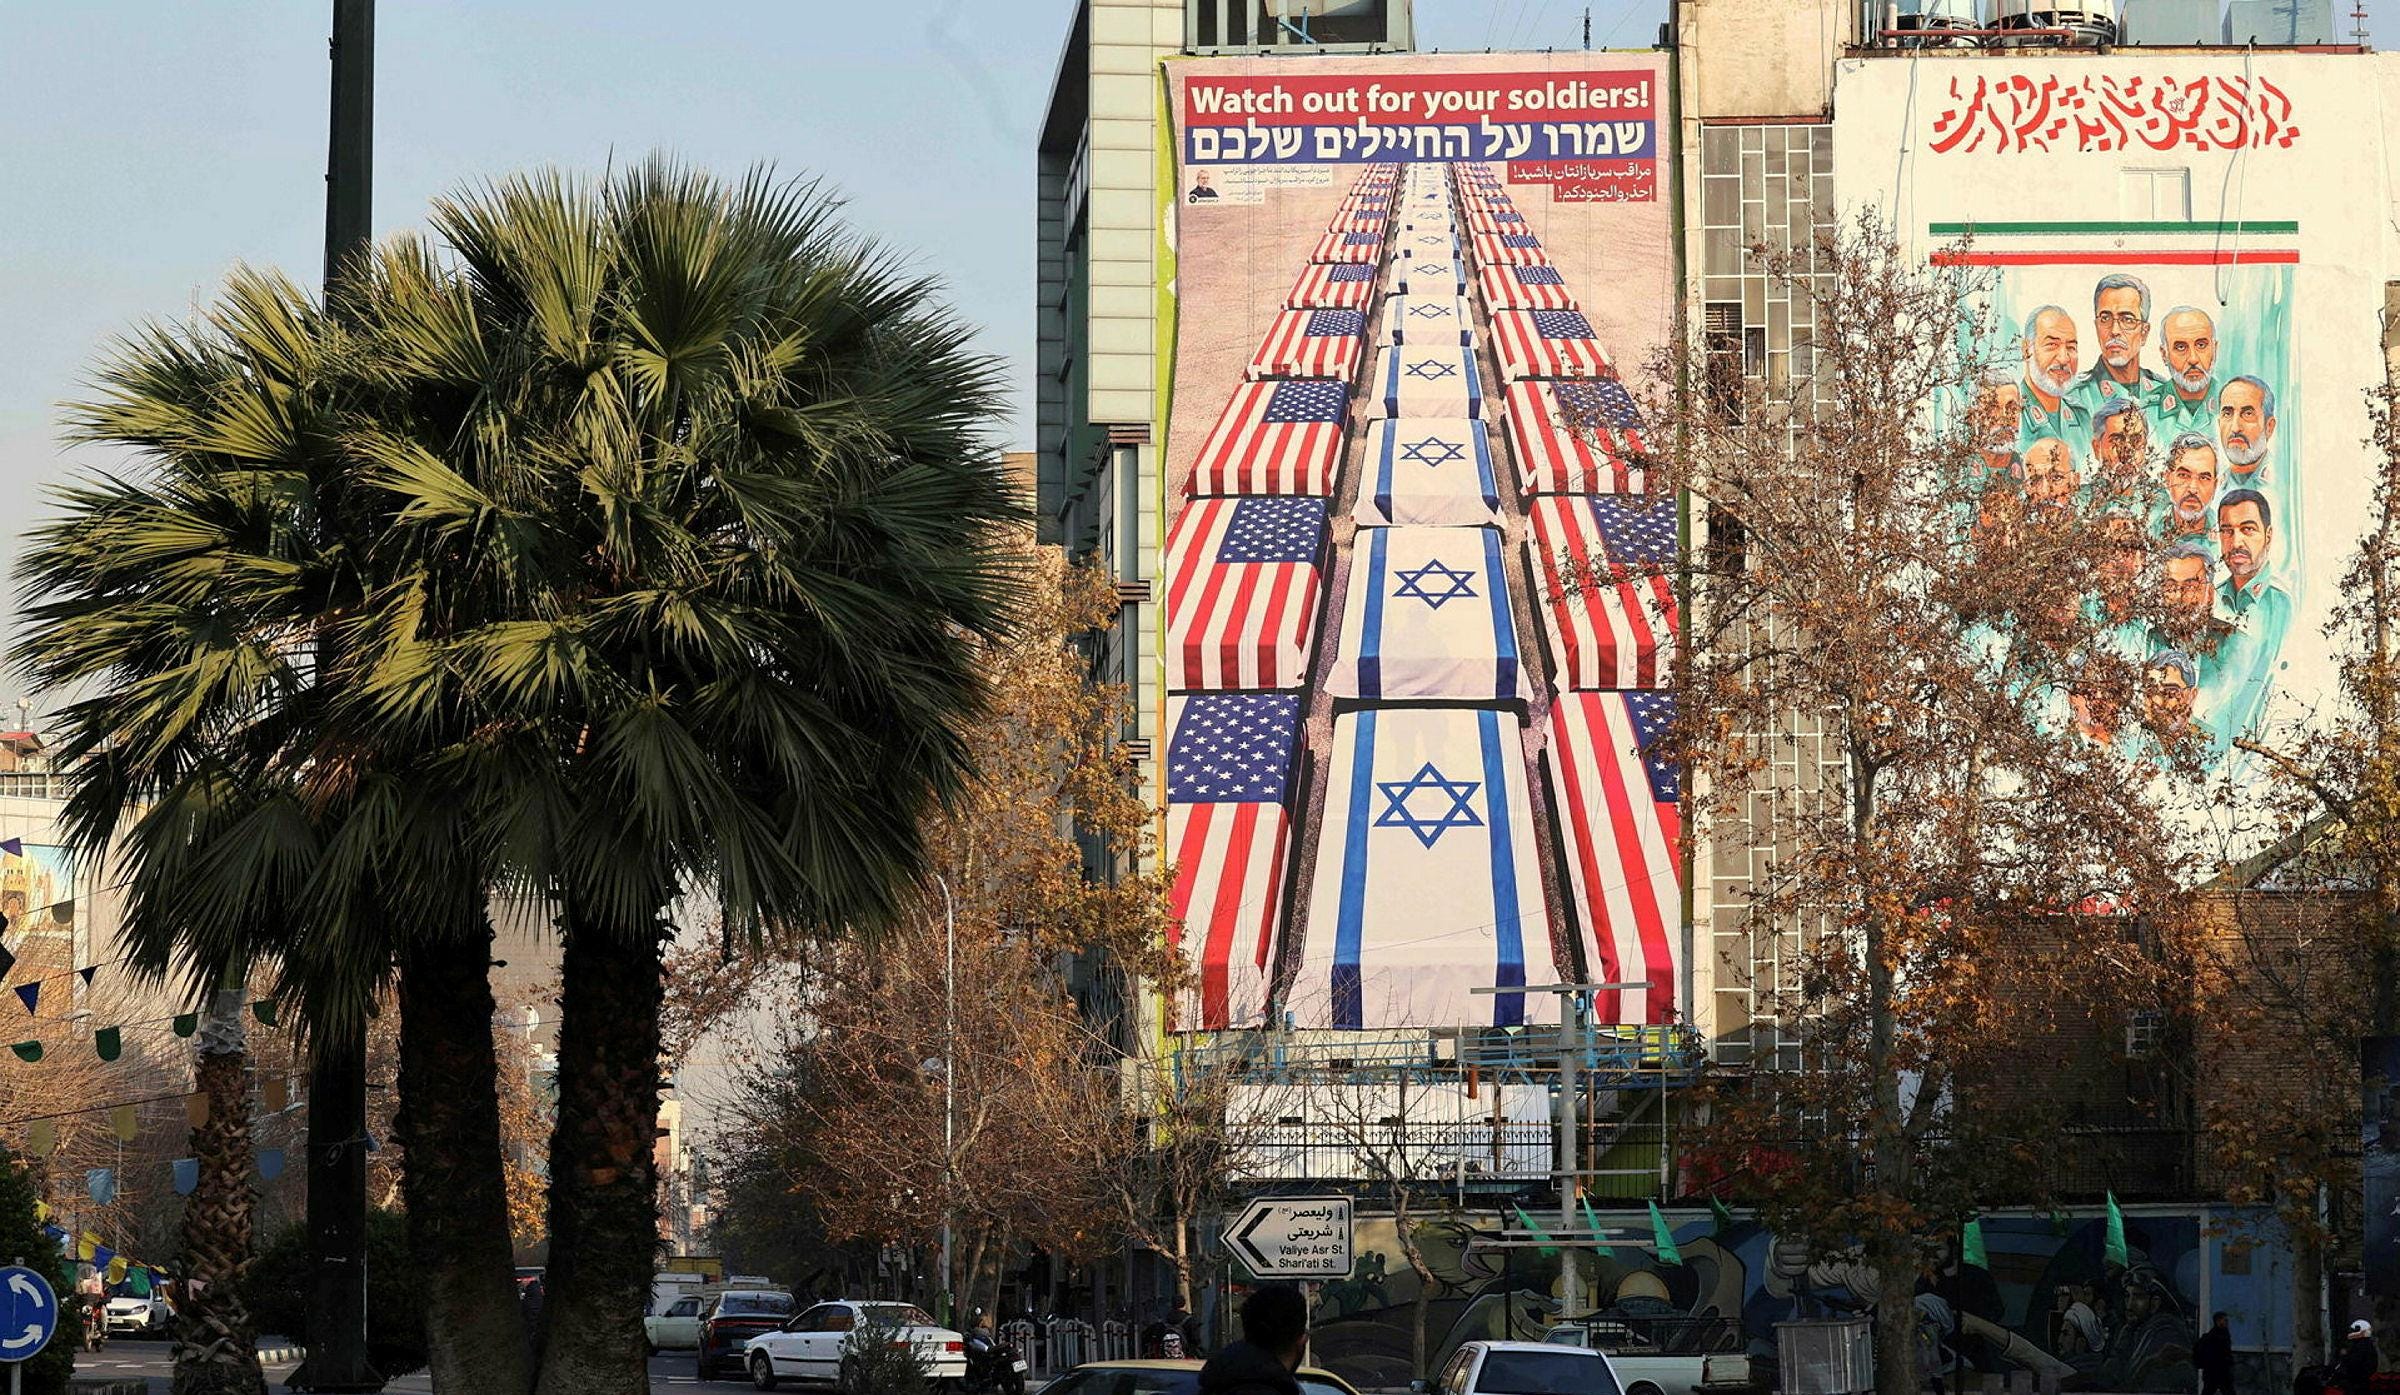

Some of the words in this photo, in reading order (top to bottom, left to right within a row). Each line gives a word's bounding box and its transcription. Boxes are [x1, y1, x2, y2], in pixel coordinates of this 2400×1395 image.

[1191, 85, 1293, 113] Watch
[1303, 87, 1359, 112] out
[1367, 84, 1416, 112] for
[1423, 90, 1500, 120] your
[1508, 80, 1649, 111] soldiers!
[1192, 117, 1303, 160] שלכם
[1314, 116, 1470, 159] החיילים
[1481, 114, 1532, 159] על
[1543, 122, 1645, 156] שמרו
[1613, 162, 1651, 180] مراقب
[1290, 1206, 1333, 1222] ولیعصر
[1287, 1224, 1333, 1242] شریعتی
[1279, 1244, 1309, 1257] Valiye
[1312, 1245, 1330, 1255] Asr
[1331, 1244, 1345, 1255] St.
[1322, 1257, 1337, 1269] St.
